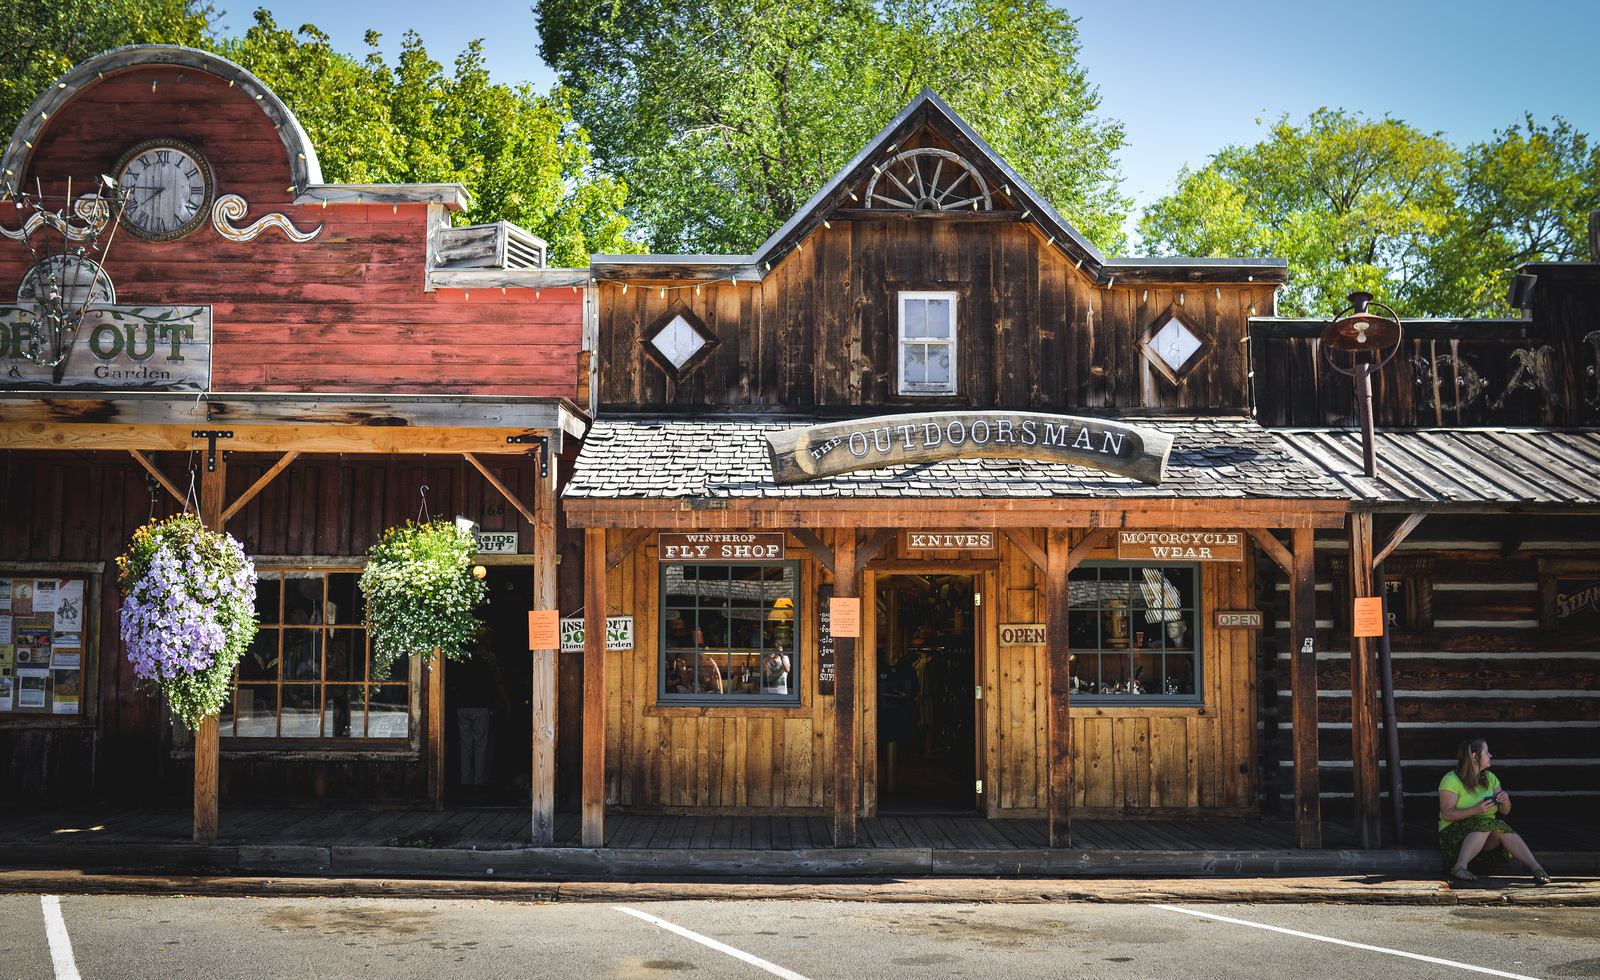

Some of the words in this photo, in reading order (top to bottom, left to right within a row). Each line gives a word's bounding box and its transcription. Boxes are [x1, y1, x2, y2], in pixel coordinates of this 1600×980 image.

[156, 151, 171, 165] XII
[190, 186, 204, 196] III
[0, 321, 38, 360] E
[89, 324, 194, 361] OUT
[8, 366, 24, 379] &
[94, 366, 171, 380] Garden
[811, 435, 842, 460] THE
[849, 420, 1126, 458] OUTDOORSMAN
[686, 534, 756, 542] WINTHROP
[911, 534, 990, 547] KNIVES
[1121, 534, 1239, 545] MOTORCYCLE
[665, 545, 710, 559] FLY
[721, 545, 780, 558] SHOP
[1150, 546, 1213, 558] WEAR
[1219, 615, 1259, 625] OPEN
[1001, 628, 1046, 644] OPEN
